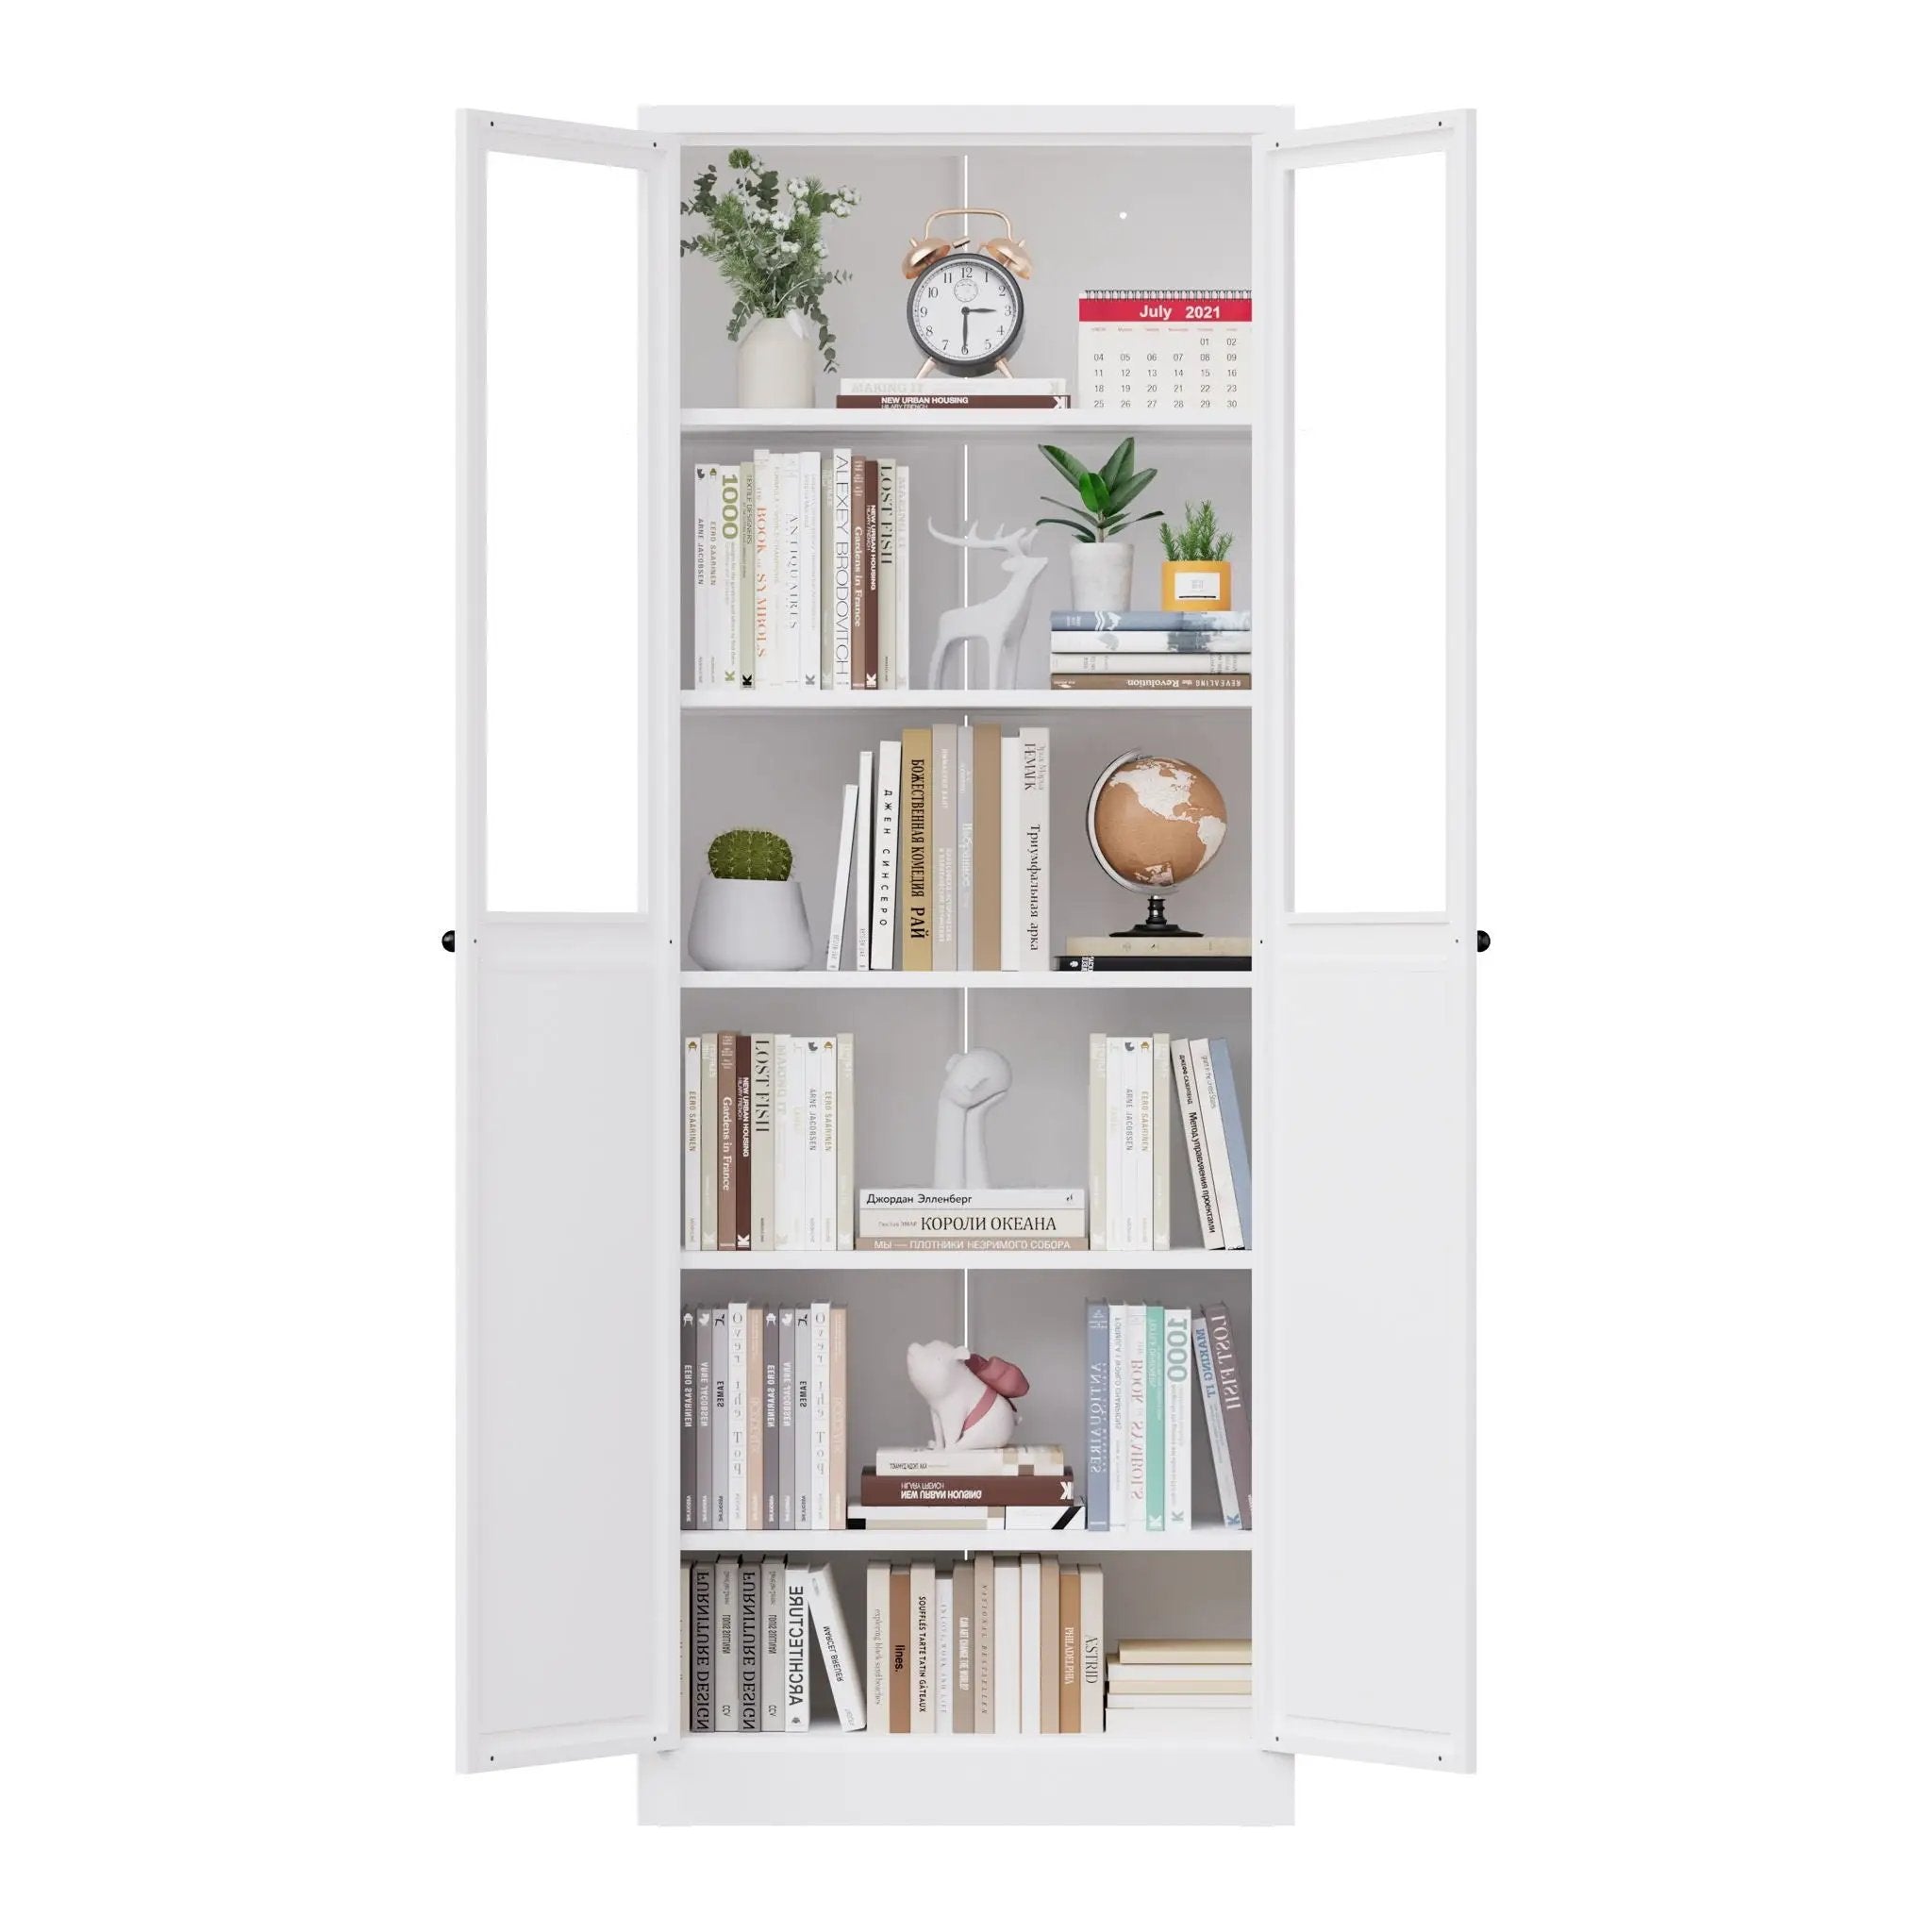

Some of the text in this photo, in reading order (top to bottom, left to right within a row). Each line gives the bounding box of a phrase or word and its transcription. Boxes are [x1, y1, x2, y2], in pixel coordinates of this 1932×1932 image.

[943, 273, 952, 283] 11
[960, 267, 973, 278] 12
[927, 287, 939, 298] 10
[998, 286, 1006, 296] 2
[920, 307, 927, 318] 9
[1004, 305, 1011, 316] 3
[1139, 305, 1221, 320] July 2021
[925, 325, 933, 336] 8
[996, 325, 1005, 335] 4
[942, 340, 948, 350] 7
[984, 339, 991, 349] 5
[1200, 338, 1238, 346] 01 02
[961, 344, 969, 355] 6
[1093, 353, 1238, 361] 04 05 06 07 08 09
[1093, 369, 1238, 377] 11 12 13 14 15 16
[1093, 400, 1238, 408] 25 26 27 28 29 30
[722, 475, 739, 540] 1000
[881, 466, 892, 564] LOST FISH
[789, 513, 799, 629] ANTIQUAIRES
[836, 455, 848, 675] ALEXEY BRODOVITCH
[854, 525, 863, 627] Gardens in France
[757, 507, 768, 658] BOOK SYMBOLS
[1127, 678, 1179, 688] Revolution
[910, 758, 929, 939] БОЖЕСТВЕННАЯ КОМЕДИЯ РАЙ
[879, 790, 893, 925] ДЖЕН СИНСЕРО
[1026, 824, 1041, 951] Триумфальная арка
[755, 1041, 770, 1132] LOST FISH
[723, 1096, 732, 1191] Gardens in France
[1189, 1112, 1198, 1138] Метод
[1202, 1190, 1215, 1233] проектами
[866, 1193, 972, 1205] Джордан Элленберг
[921, 1216, 1057, 1231] КОРОЛИ ОКЕАНА
[874, 1240, 1071, 1249] МЫ ПЛОТНИКИ НЕЗРИМОГО СОБОРА
[895, 1644, 905, 1673] lines.
[918, 1596, 928, 1712] SOUFFLÉS TARTE TATIN GÂTEAUX
[1064, 1627, 1074, 1685] PHILADELPHIA
